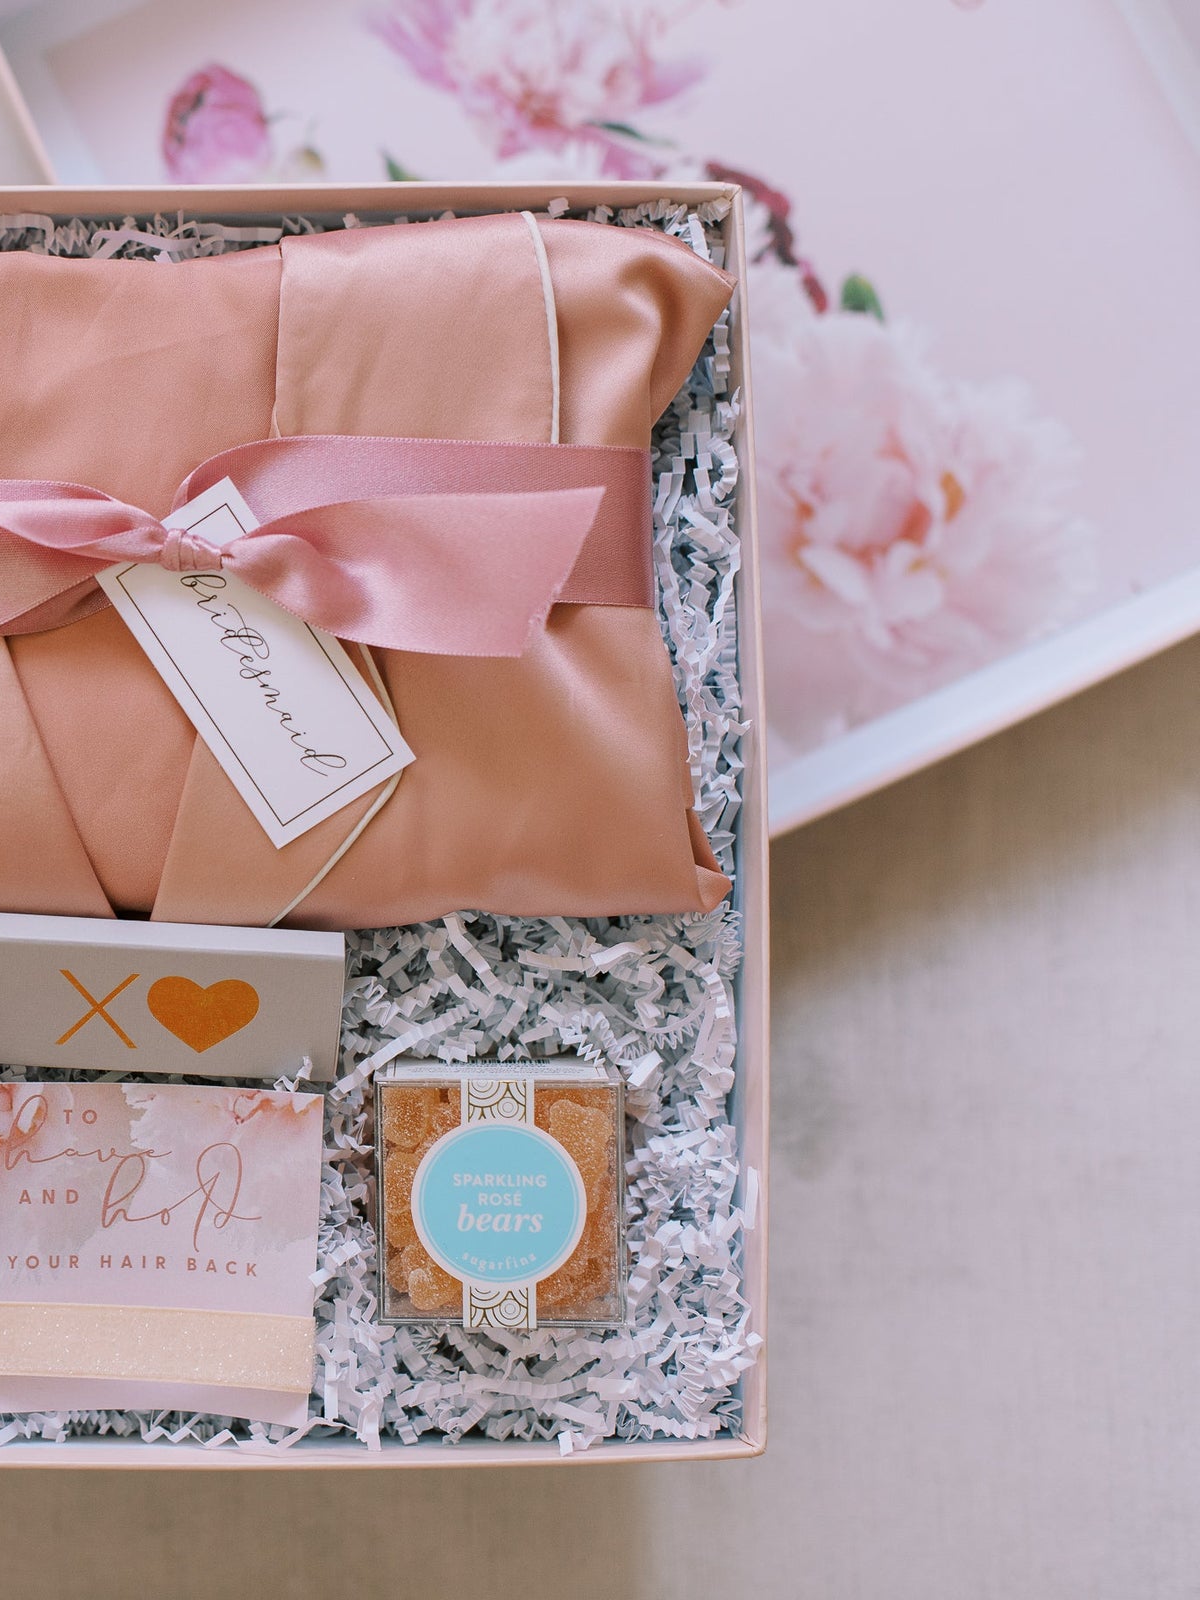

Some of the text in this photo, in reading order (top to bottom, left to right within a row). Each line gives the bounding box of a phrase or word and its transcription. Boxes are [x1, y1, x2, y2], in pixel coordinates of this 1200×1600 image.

[180, 573, 347, 777] bridesmaid
[63, 1109, 98, 1125] TO
[4, 1094, 172, 1171] have
[453, 1173, 547, 1188] SPARKLING
[18, 1142, 262, 1253] AND hold
[478, 1191, 522, 1207] ROSÉ
[457, 1203, 544, 1233] bears
[7, 1255, 258, 1278] YOUR HAIR BACK
[463, 1252, 537, 1272] sugarfina
